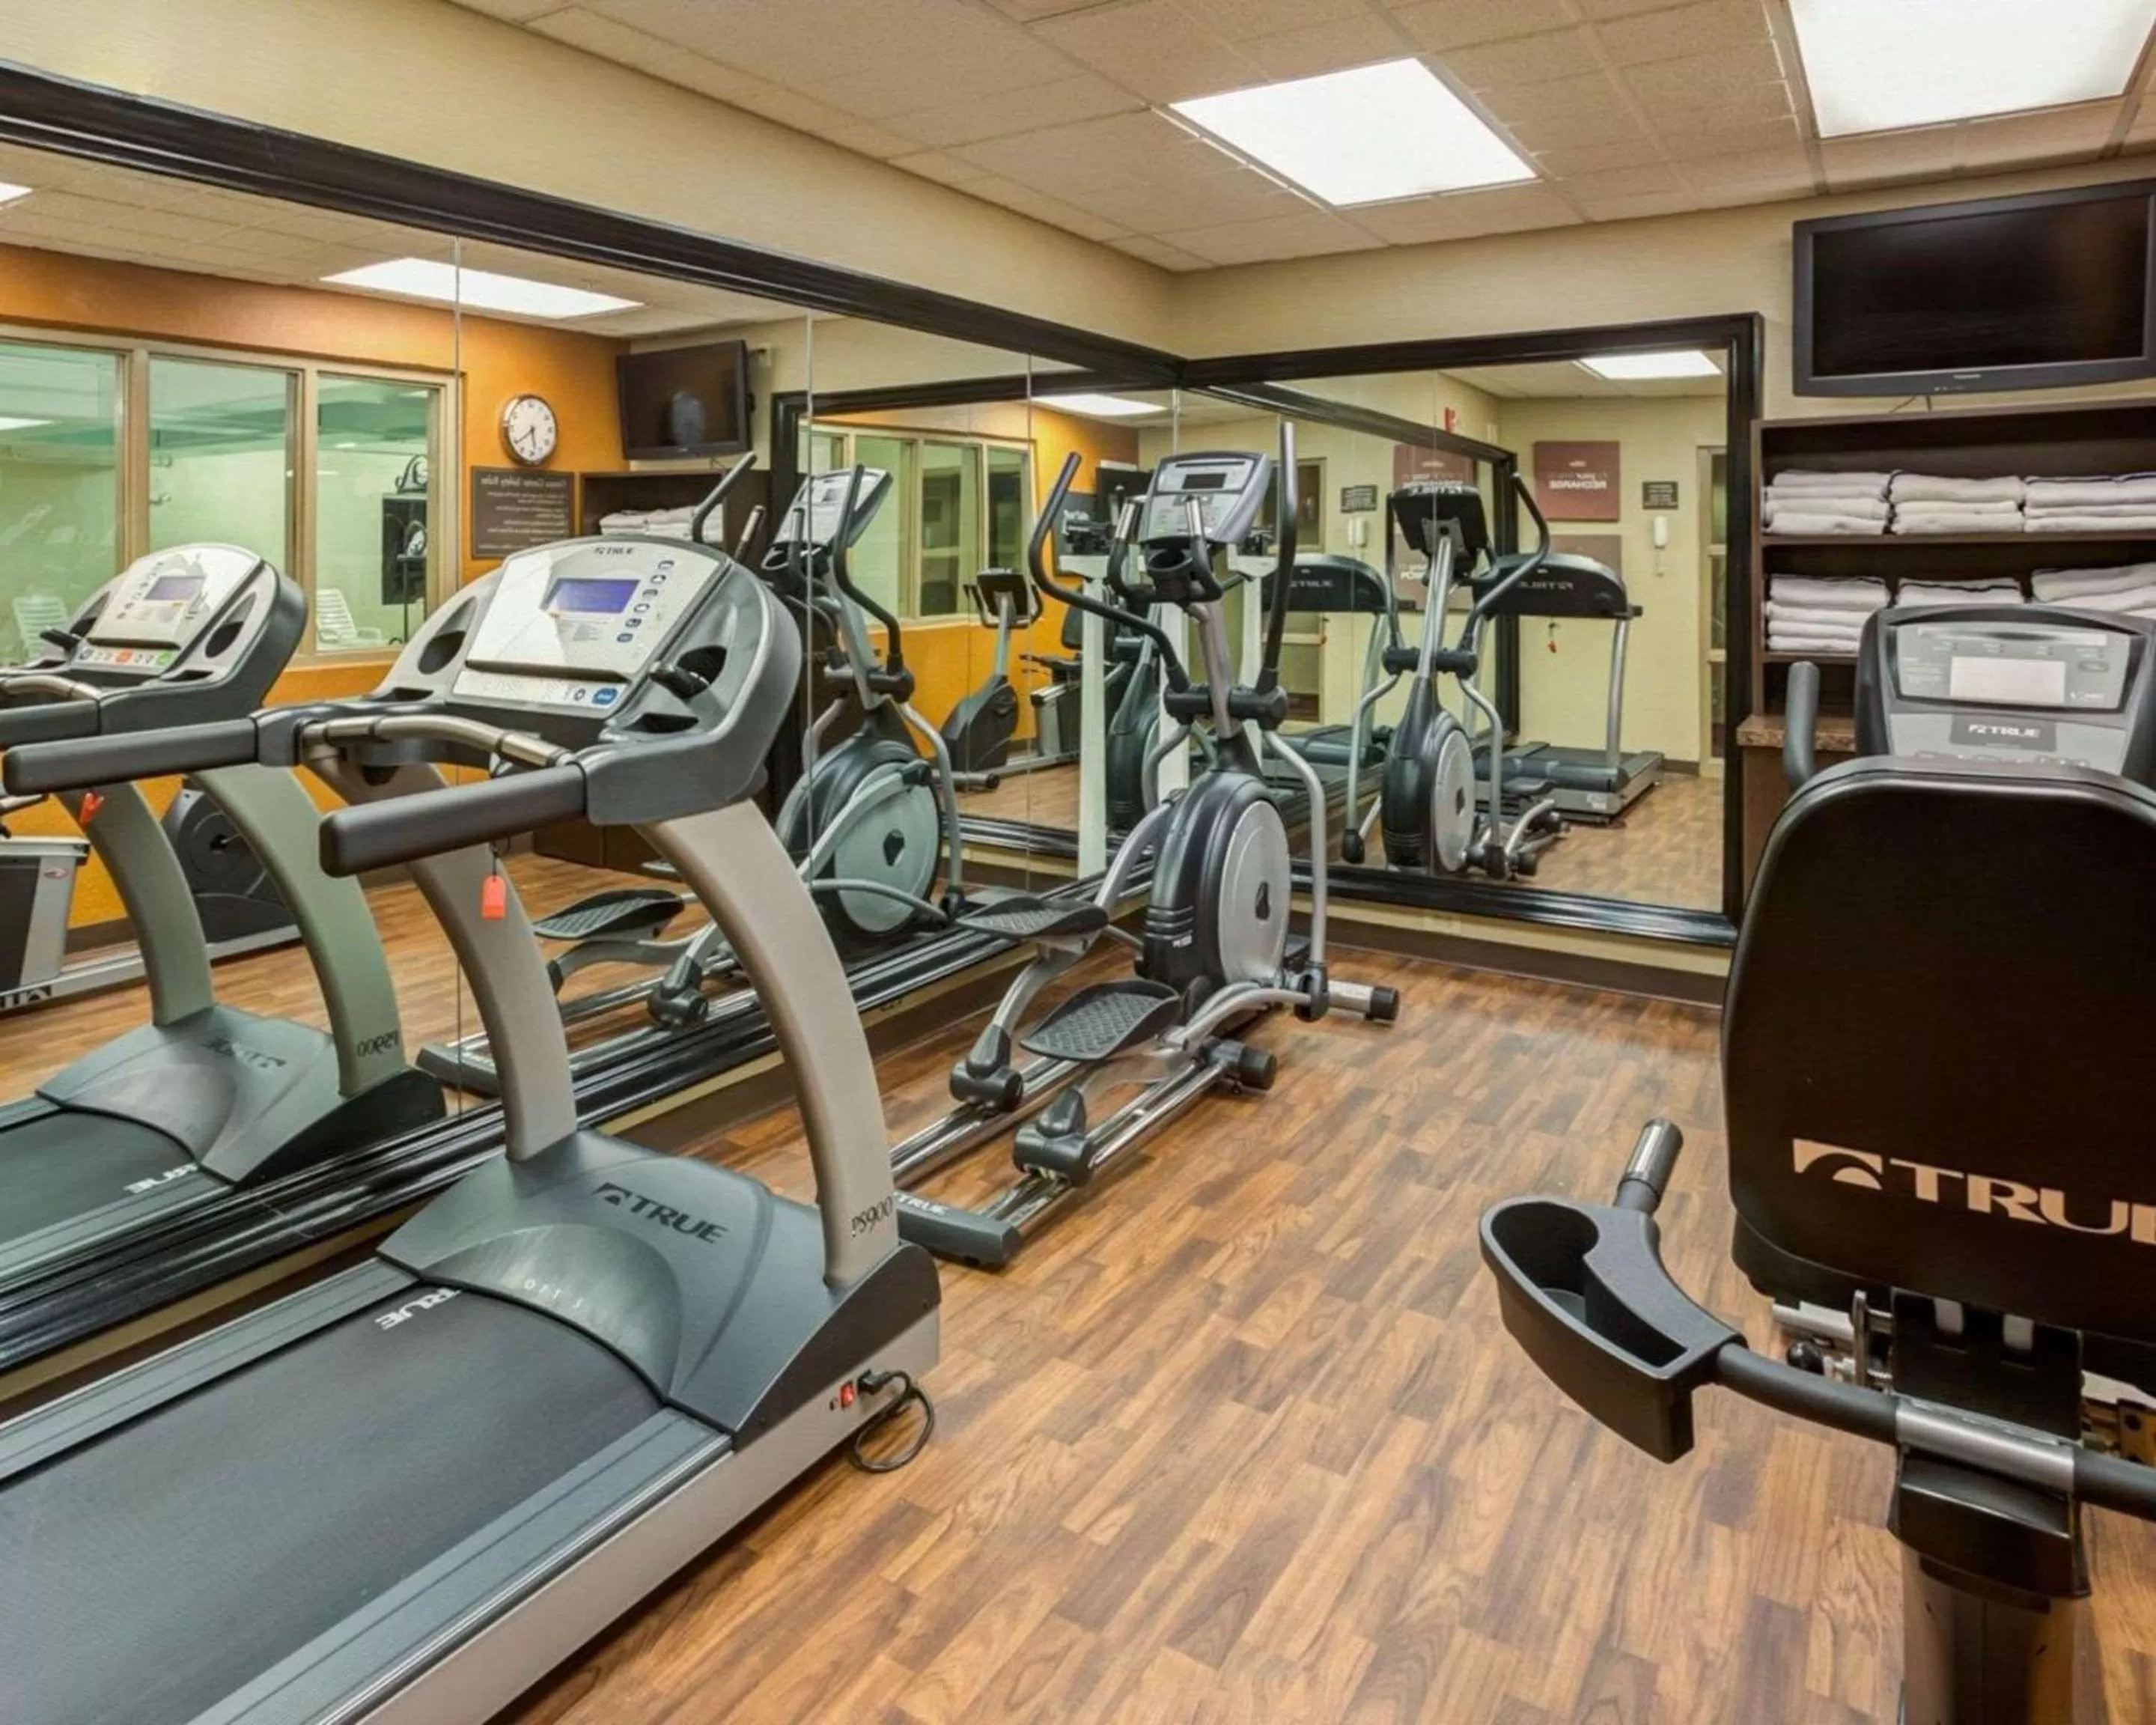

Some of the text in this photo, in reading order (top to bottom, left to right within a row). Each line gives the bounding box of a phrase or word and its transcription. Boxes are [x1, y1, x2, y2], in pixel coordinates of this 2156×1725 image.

[1991, 725, 2041, 737] TRUE
[630, 1194, 730, 1244] TRUE
[374, 1287, 462, 1330] RUE
